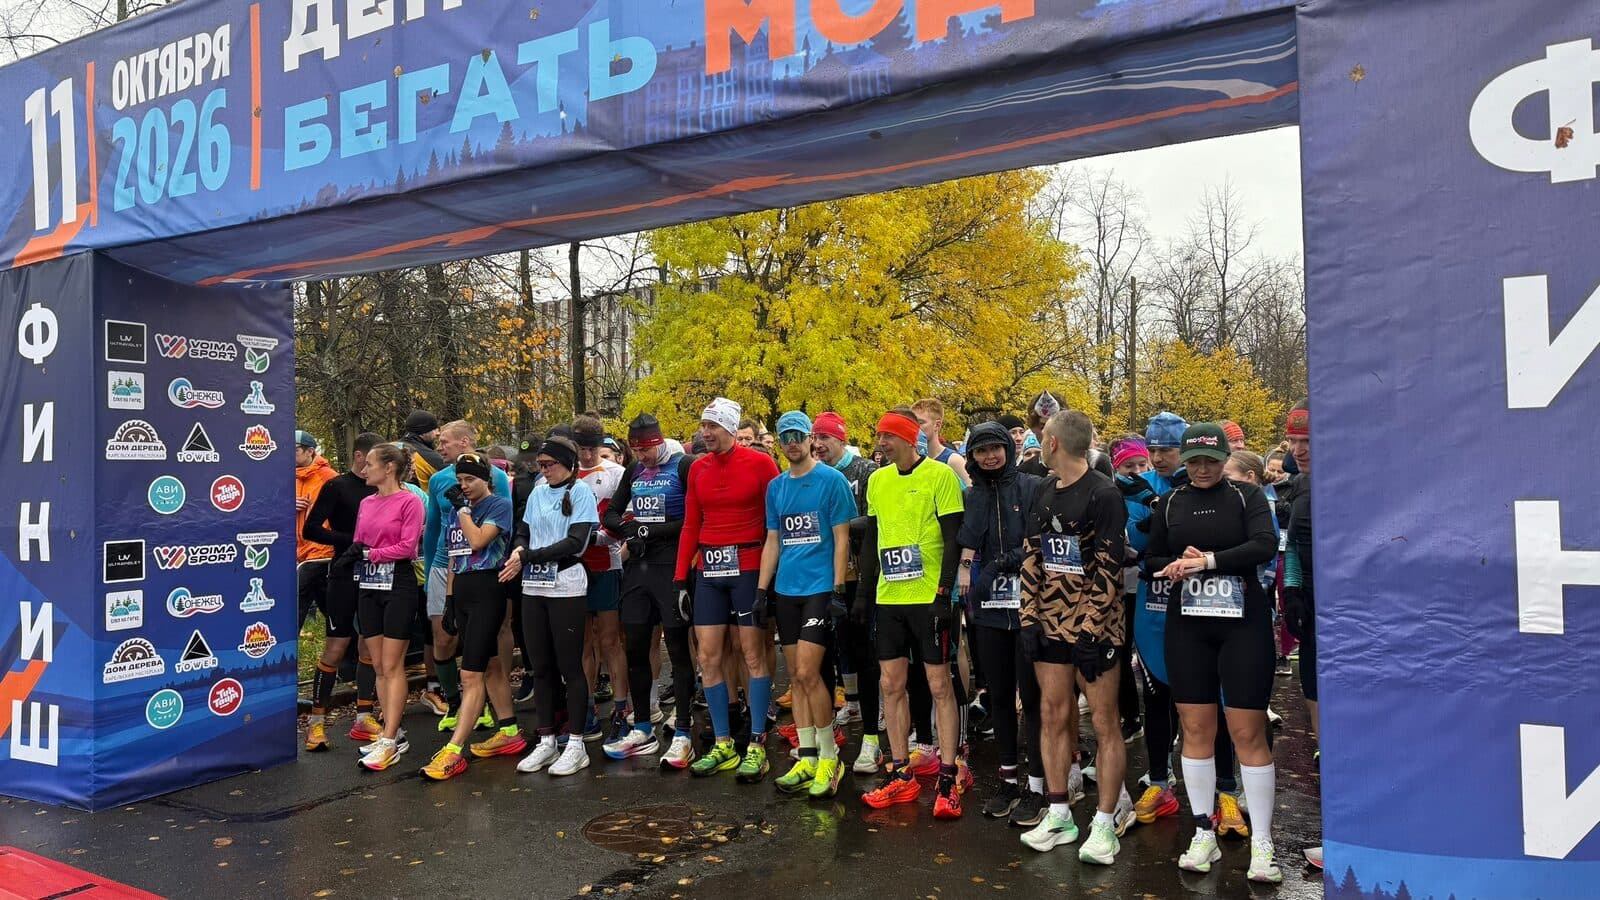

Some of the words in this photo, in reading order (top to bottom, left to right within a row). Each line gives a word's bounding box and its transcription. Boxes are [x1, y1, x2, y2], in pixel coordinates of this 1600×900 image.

[283, 0, 462, 72] ДЕ
[111, 23, 231, 111] ОКТЯБРЯ
[284, 18, 658, 171] БЕГАТЬ
[24, 78, 77, 231] 11
[112, 88, 231, 213] 2026
[191, 341, 236, 352] VOIMA
[190, 349, 236, 360] SPORT
[186, 391, 222, 401] ОНЕЖЕЦ
[178, 453, 218, 461] TOWER
[156, 485, 178, 494] АВИ
[636, 496, 660, 511] 082
[785, 515, 812, 531] 093
[10, 303, 59, 766] ФИНИШ
[190, 545, 236, 556] VOIMA
[1048, 538, 1071, 556] 137
[189, 553, 236, 564] SPORT
[705, 549, 732, 565] 095
[884, 549, 913, 566] 150
[364, 562, 386, 576] 104
[530, 562, 550, 574] 153
[992, 575, 1017, 592] 121
[1151, 580, 1172, 596] 08
[1188, 578, 1233, 598] 060
[184, 596, 221, 608] ОНЕЖЕЦ
[105, 665, 126, 674] ДОМ
[128, 660, 163, 671] ДЕРЕВА
[177, 659, 217, 672] TOWER
[154, 698, 176, 709] АВИ
